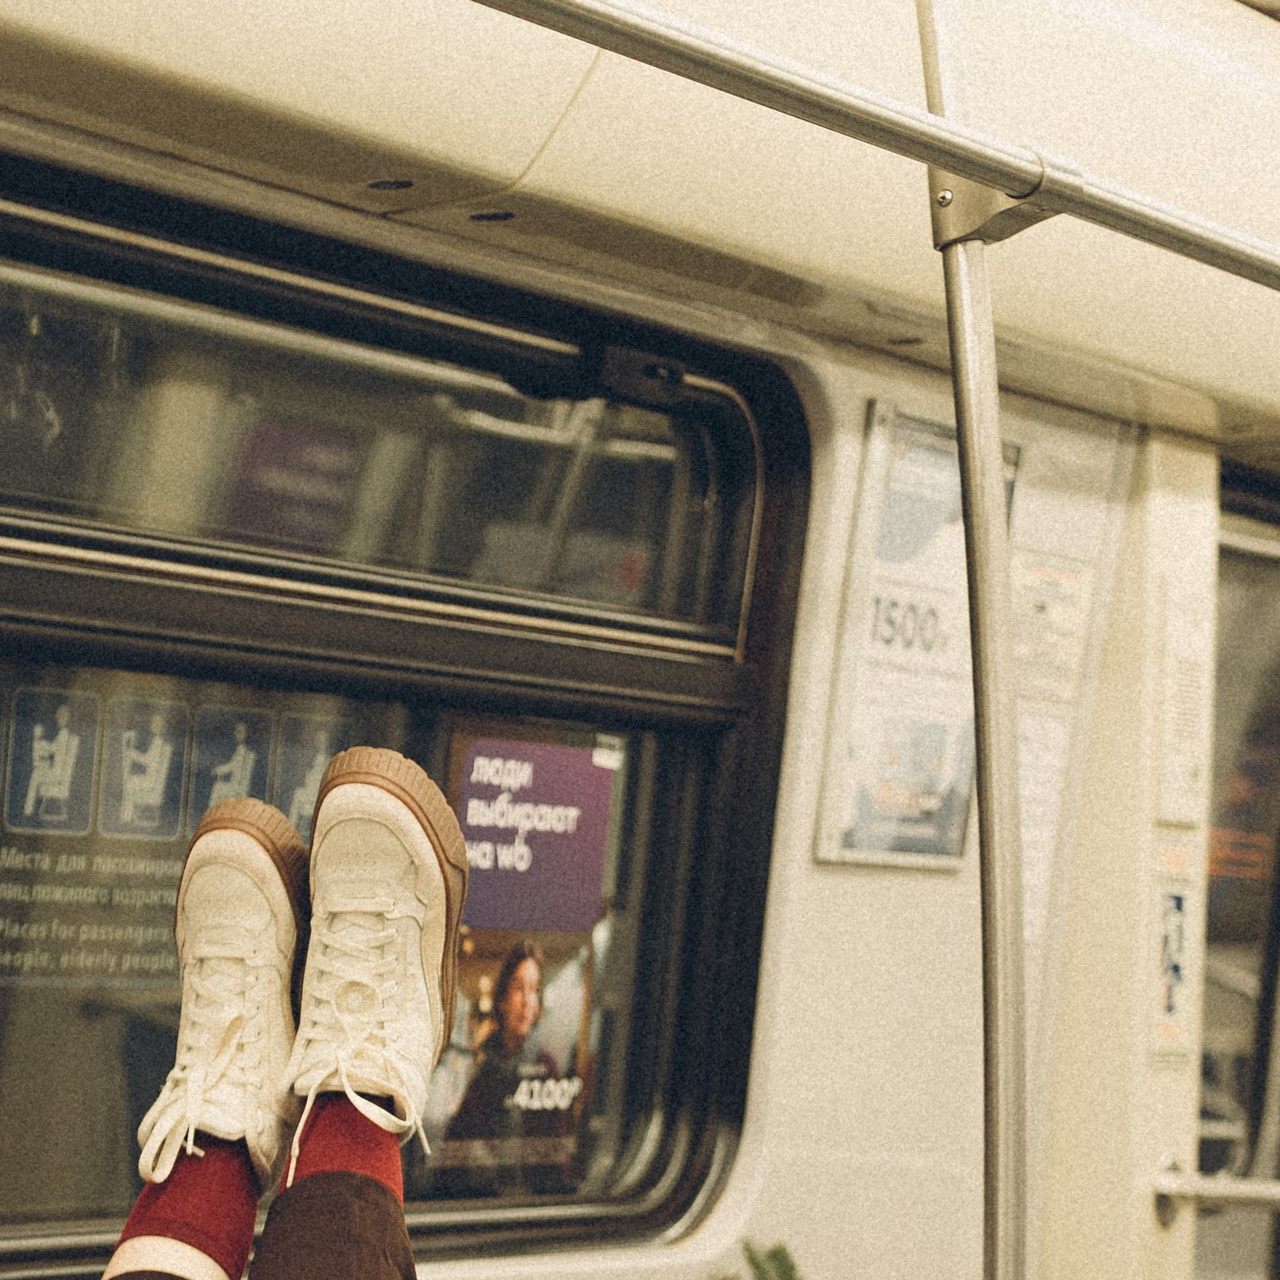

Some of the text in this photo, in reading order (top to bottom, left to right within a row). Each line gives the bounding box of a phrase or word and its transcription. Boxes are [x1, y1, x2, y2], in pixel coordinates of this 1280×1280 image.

[467, 794, 582, 838] выбирают
[0, 847, 51, 871] Места
[56, 854, 87, 873] для
[51, 919, 76, 940] for
